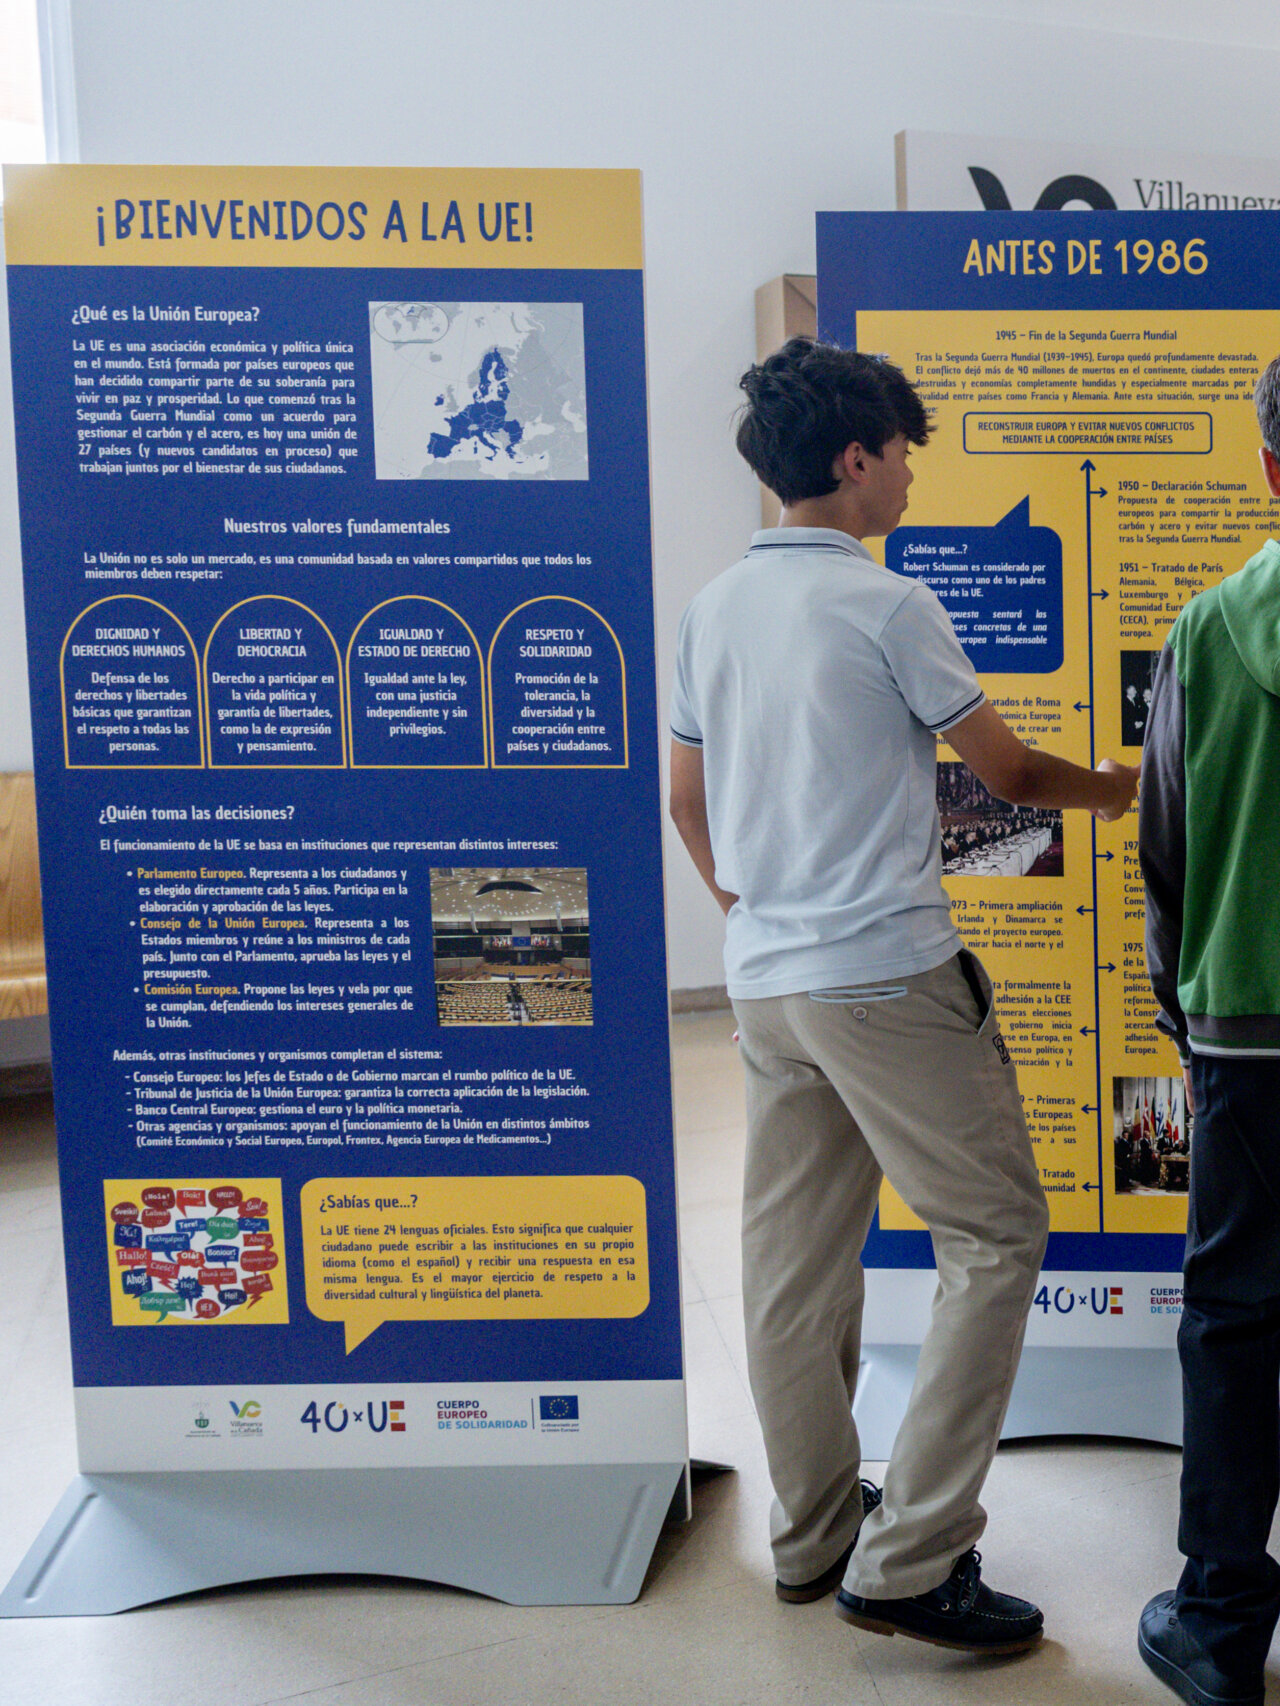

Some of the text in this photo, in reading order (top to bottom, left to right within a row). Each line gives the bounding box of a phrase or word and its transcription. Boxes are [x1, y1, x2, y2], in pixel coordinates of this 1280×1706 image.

[97, 199, 533, 247] ¡BIENVENIDOS A LA UE!
[963, 238, 1208, 276] ANTES DE 1986
[72, 306, 260, 325] ¿Qué es la Unión Europea?
[997, 330, 1017, 340] 1945
[1029, 330, 1042, 340] Fin
[1045, 331, 1055, 340] de
[1059, 331, 1066, 340] la
[1069, 330, 1107, 343] Segunda
[1110, 330, 1141, 340] Guerra
[1144, 330, 1177, 340] Mundial
[73, 340, 354, 355] La UE es una asociación económica y política única
[978, 422, 1195, 431] RECONSTRUIR EUROPA Y EVITAR NUEVOS CONFLICTOS
[1002, 433, 1173, 444] MEDIANTE LA COOPERACIÓN ENTRE PAÍSES
[1118, 481, 1139, 491] 1950
[1152, 481, 1203, 491] Declaración
[1206, 481, 1247, 491] Schuman
[224, 518, 450, 537] Nuestros valores fundamentales
[903, 544, 968, 557] ¿Sabías que...?
[904, 562, 930, 571] Robert
[933, 562, 968, 571] Schuman
[983, 563, 1030, 571] considerado
[1033, 565, 1046, 573] por
[1120, 563, 1139, 572] 1951
[1152, 563, 1185, 572] Tratado
[1188, 563, 1198, 572] de
[1201, 563, 1223, 572] París
[96, 628, 160, 640] DIGNIDAD Y
[240, 628, 302, 640] LIBERTAD Y
[380, 629, 444, 640] IGUALDAD Y
[526, 629, 584, 640] RESPETO Y
[1120, 630, 1154, 639] europea.
[72, 645, 186, 657] DERECHOS HUMANOS
[238, 645, 307, 657] DEMOCRACIA
[358, 646, 470, 657] ESTADO DE DERECHO
[520, 646, 592, 657] SOLIDARIDAD
[991, 697, 1061, 706] atados de Roma
[1030, 711, 1061, 721] Europea
[99, 805, 295, 824] ¿Quién toma las decisiones?
[138, 867, 407, 881] Parlamento Europeo. Representa a los ciudadanos y
[952, 900, 967, 910] 973
[979, 900, 1013, 910] Primera
[1017, 900, 1062, 912] ampliación
[1123, 943, 1143, 952] 1975
[1125, 1046, 1158, 1055] Europea.
[1037, 1095, 1076, 1105] Primeras
[1033, 1109, 1073, 1120] Europeas
[1043, 1168, 1075, 1178] Tratado
[320, 1194, 418, 1213] ¿Sabías que...?
[119, 1250, 147, 1260] Hallo!
[126, 1274, 148, 1286] Ahoj!
[437, 1400, 480, 1409] CUERPO
[438, 1410, 488, 1419] EUROPEO
[438, 1420, 528, 1430] DE SOLIDARIDAD
